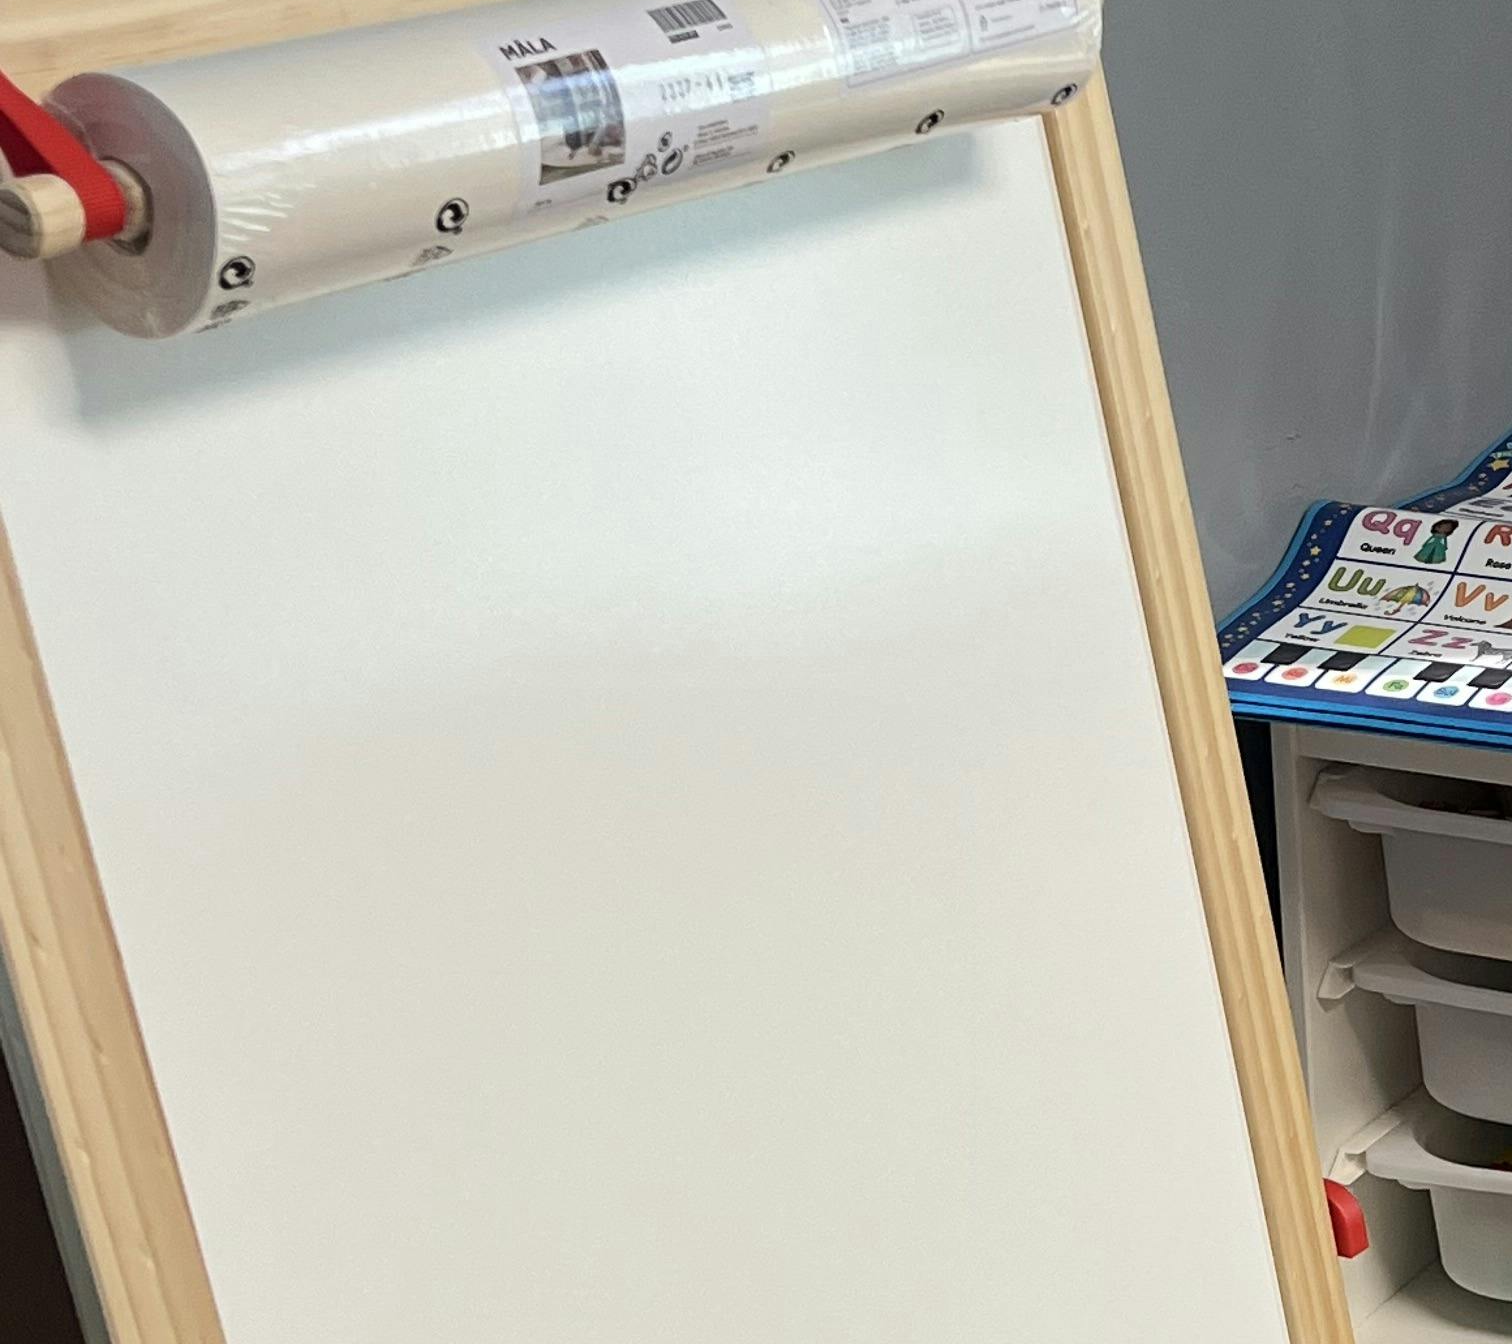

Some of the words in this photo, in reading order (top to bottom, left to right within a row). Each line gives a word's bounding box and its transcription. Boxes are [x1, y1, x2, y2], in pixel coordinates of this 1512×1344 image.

[1362, 510, 1423, 546] Qq
[1360, 542, 1397, 556] Queen
[1328, 566, 1387, 596] Uu
[1455, 581, 1510, 612] Vv
[1293, 612, 1349, 635] Yy
[1407, 629, 1474, 650] Zz
